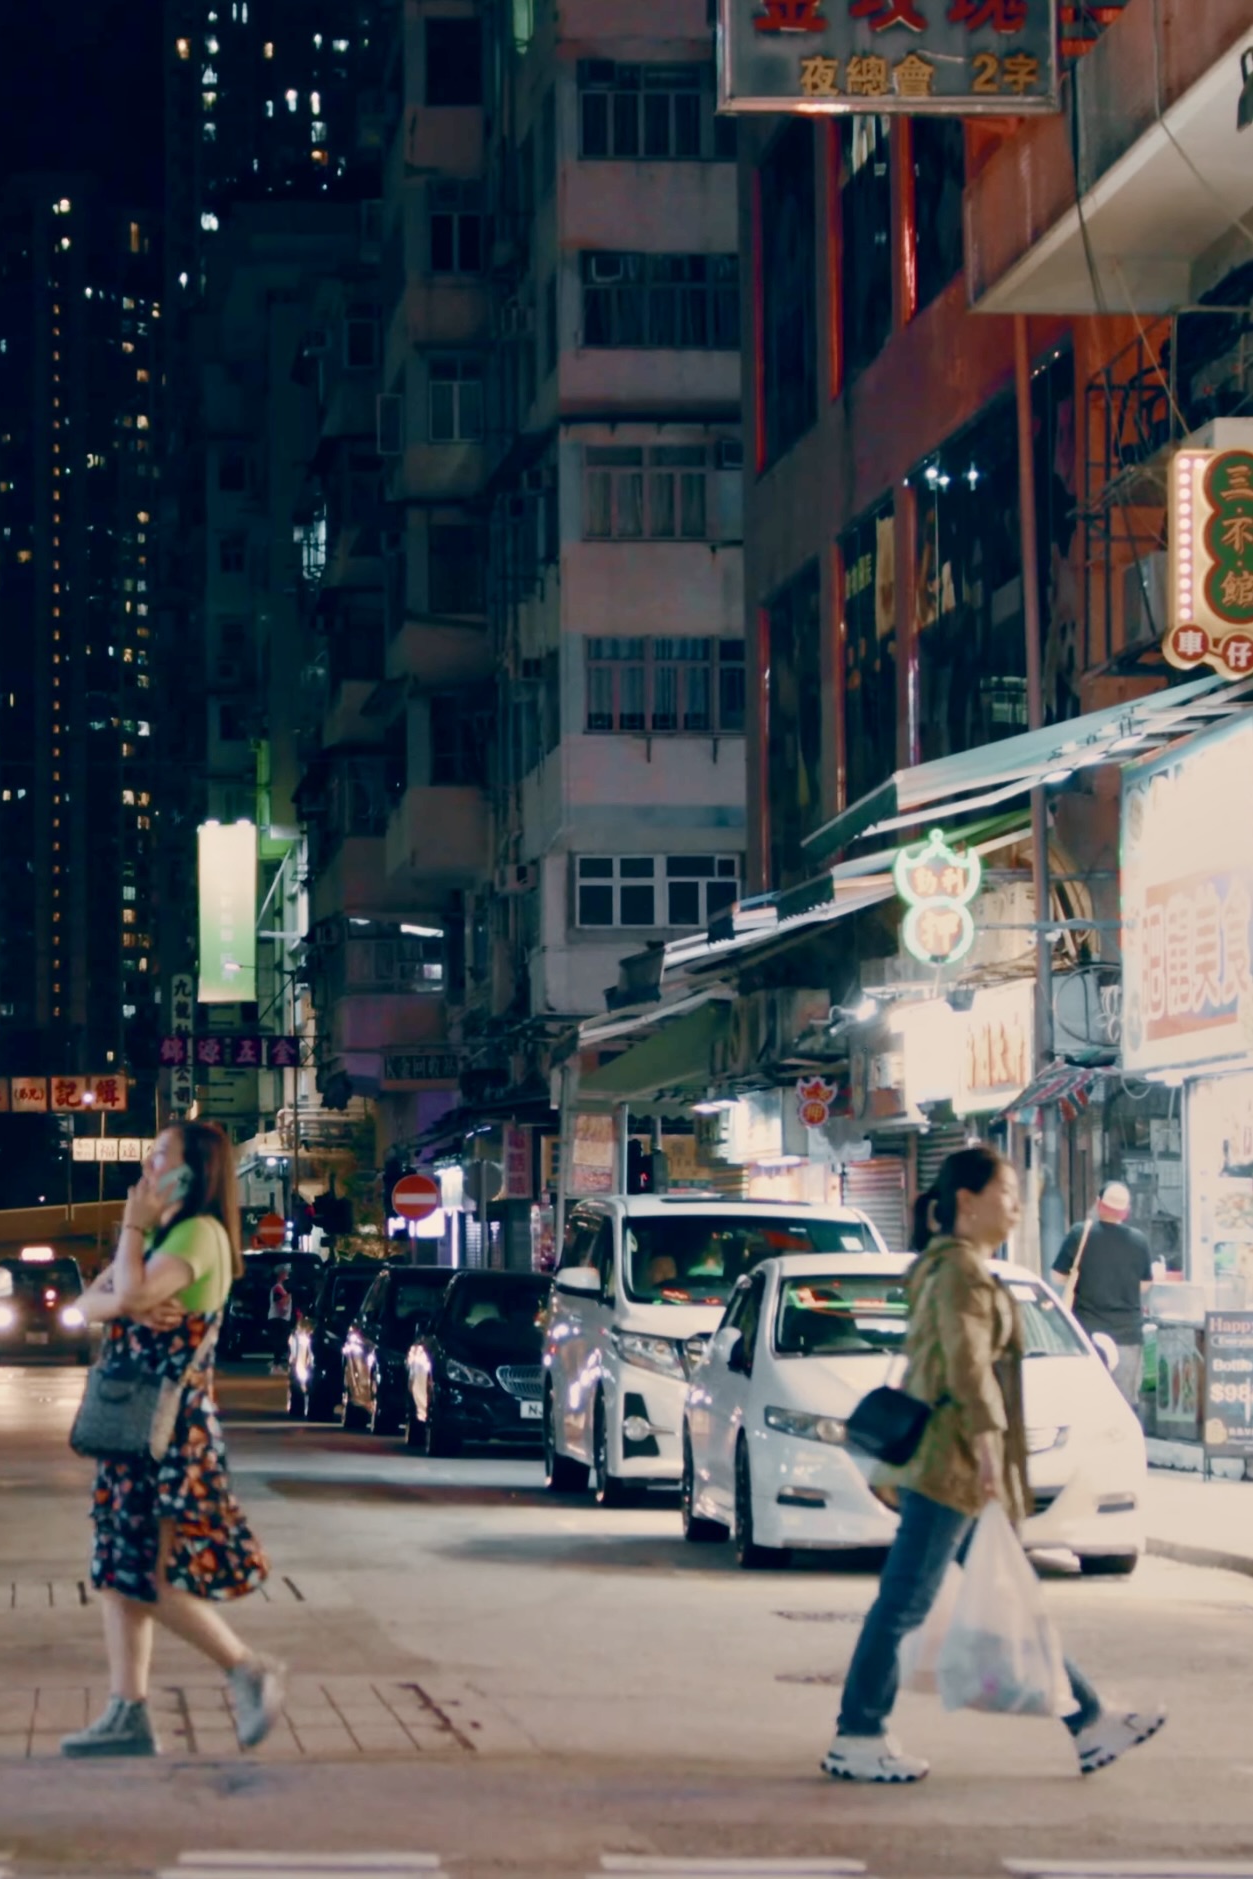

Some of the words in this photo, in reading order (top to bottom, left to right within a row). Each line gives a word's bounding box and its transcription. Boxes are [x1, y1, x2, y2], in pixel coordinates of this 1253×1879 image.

[801, 55, 935, 97] 夜總會
[1178, 630, 1252, 668] 車仔
[1210, 1317, 1253, 1333] Happ
